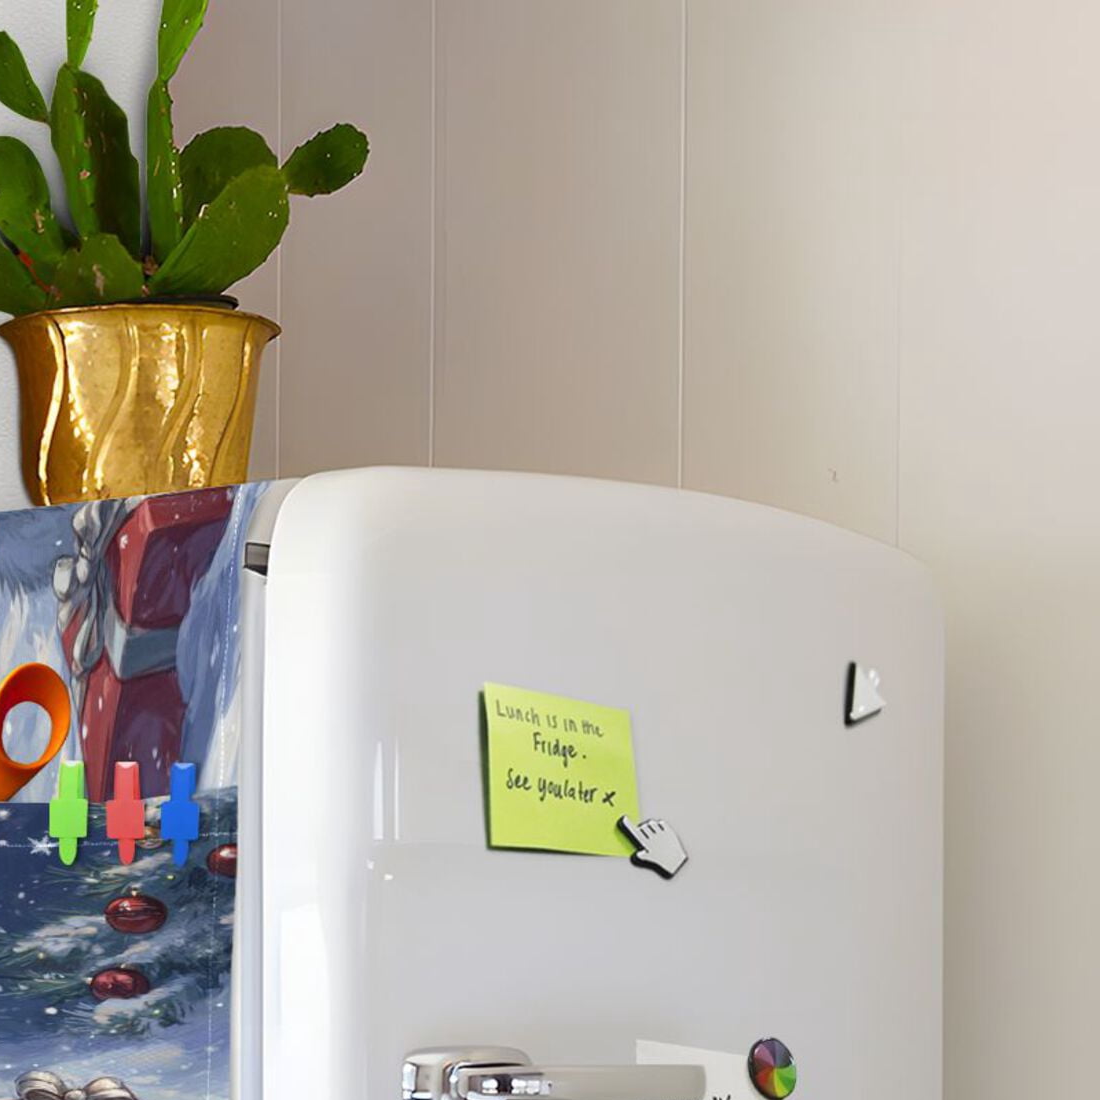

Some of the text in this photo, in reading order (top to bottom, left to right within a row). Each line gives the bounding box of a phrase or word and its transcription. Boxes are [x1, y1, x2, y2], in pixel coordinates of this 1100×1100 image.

[495, 699, 604, 738] Lunch is in the
[505, 767, 532, 791] See
